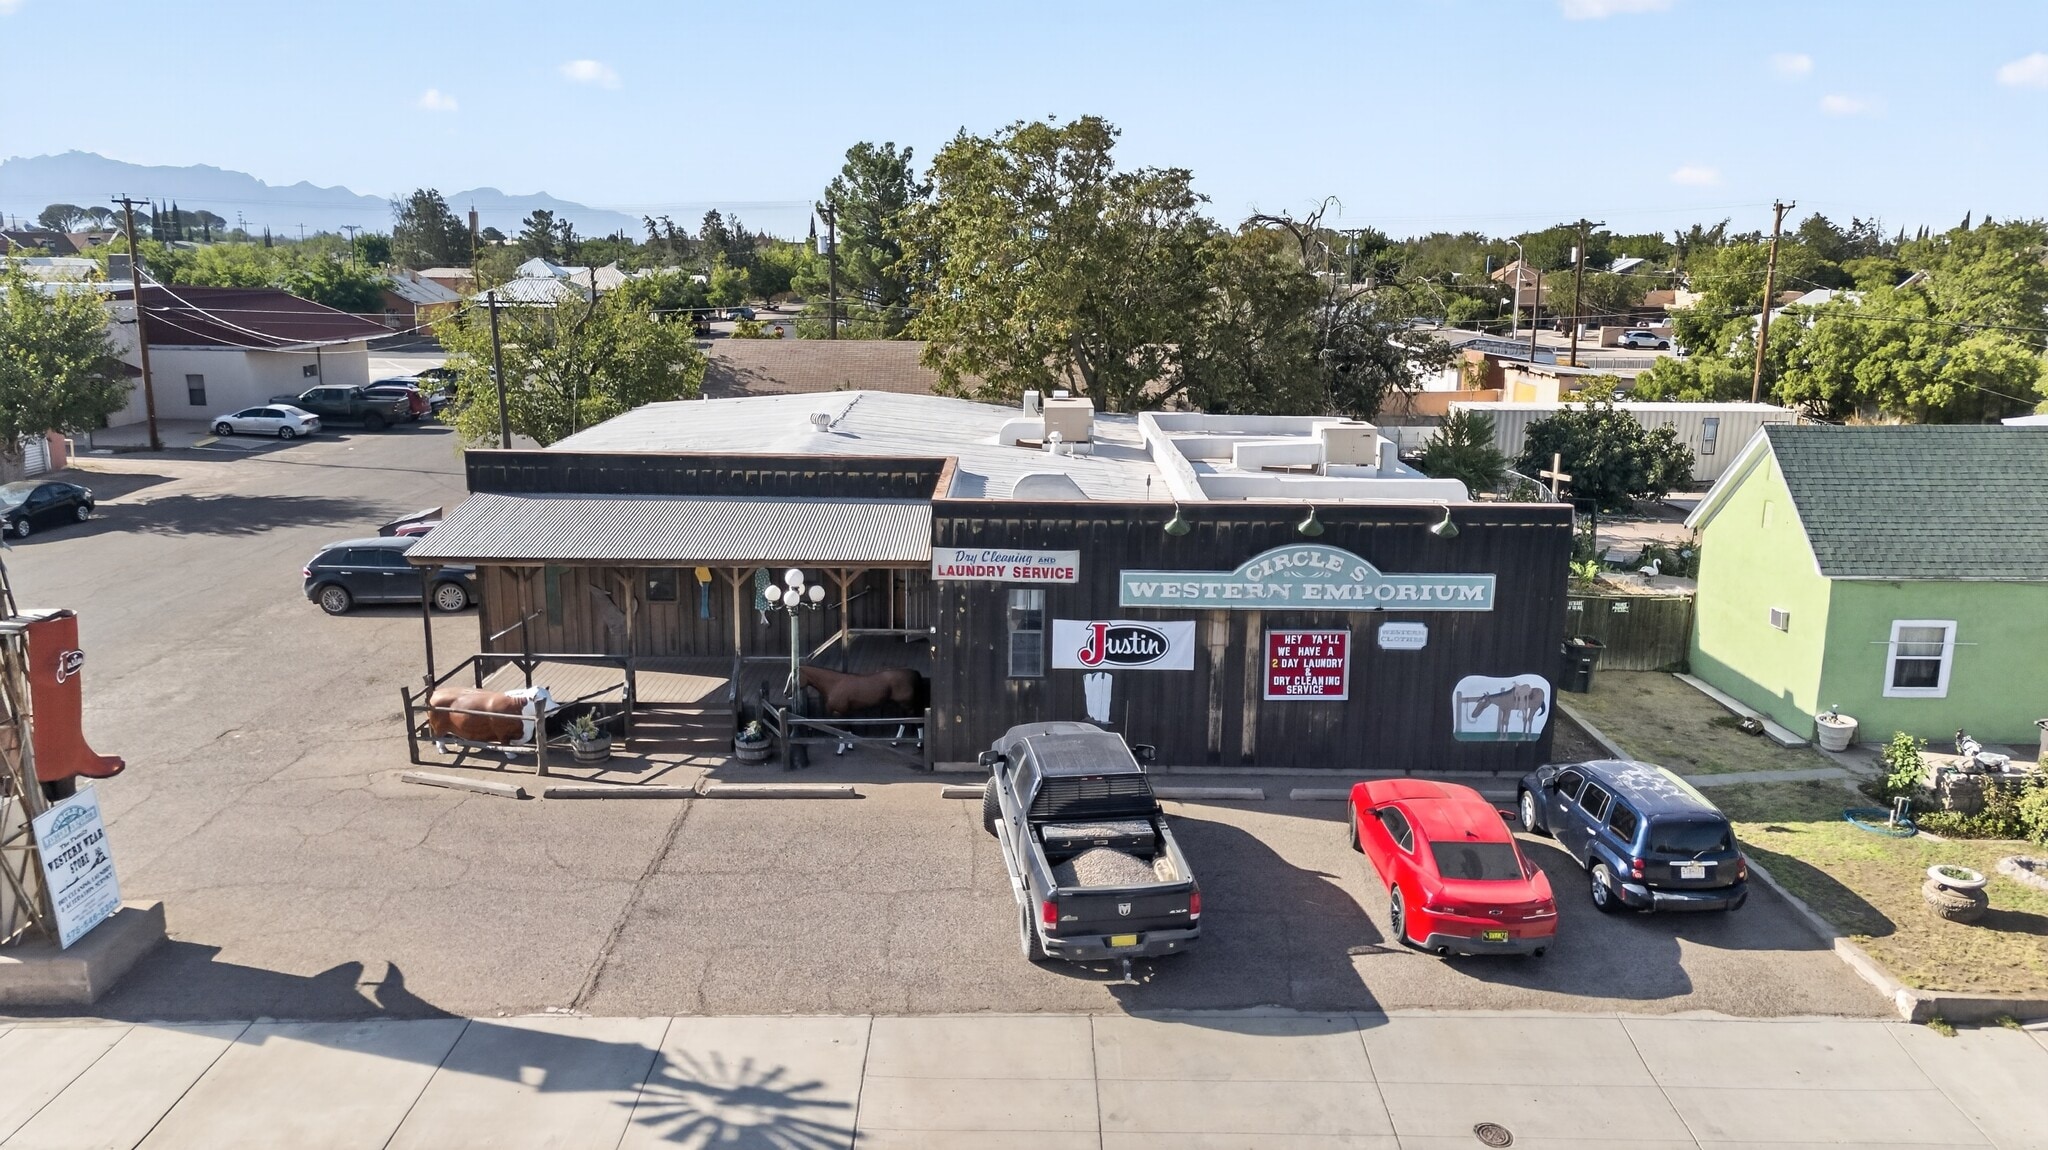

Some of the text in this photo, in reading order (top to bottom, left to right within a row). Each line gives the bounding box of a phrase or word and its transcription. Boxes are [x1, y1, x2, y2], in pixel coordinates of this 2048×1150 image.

[955, 550, 1056, 566] Dry Cleaning AND
[937, 565, 1074, 580] LAUNDRY SERVICE
[1245, 551, 1369, 583] CIRCLE S
[1127, 582, 1485, 601] WESTERN EMPORIUM
[1079, 622, 1162, 666] Justin
[1284, 634, 1340, 644] HEY YA'LL
[1277, 646, 1334, 656] WE HAVE A
[1271, 658, 1343, 668] 2 DAY LAUNDRY
[1304, 667, 1312, 677] &
[1273, 676, 1341, 686] DRY CLEANING
[1286, 685, 1324, 694] SERVICE
[47, 828, 104, 872] WESTERN WEAR
[69, 852, 90, 874] STORE
